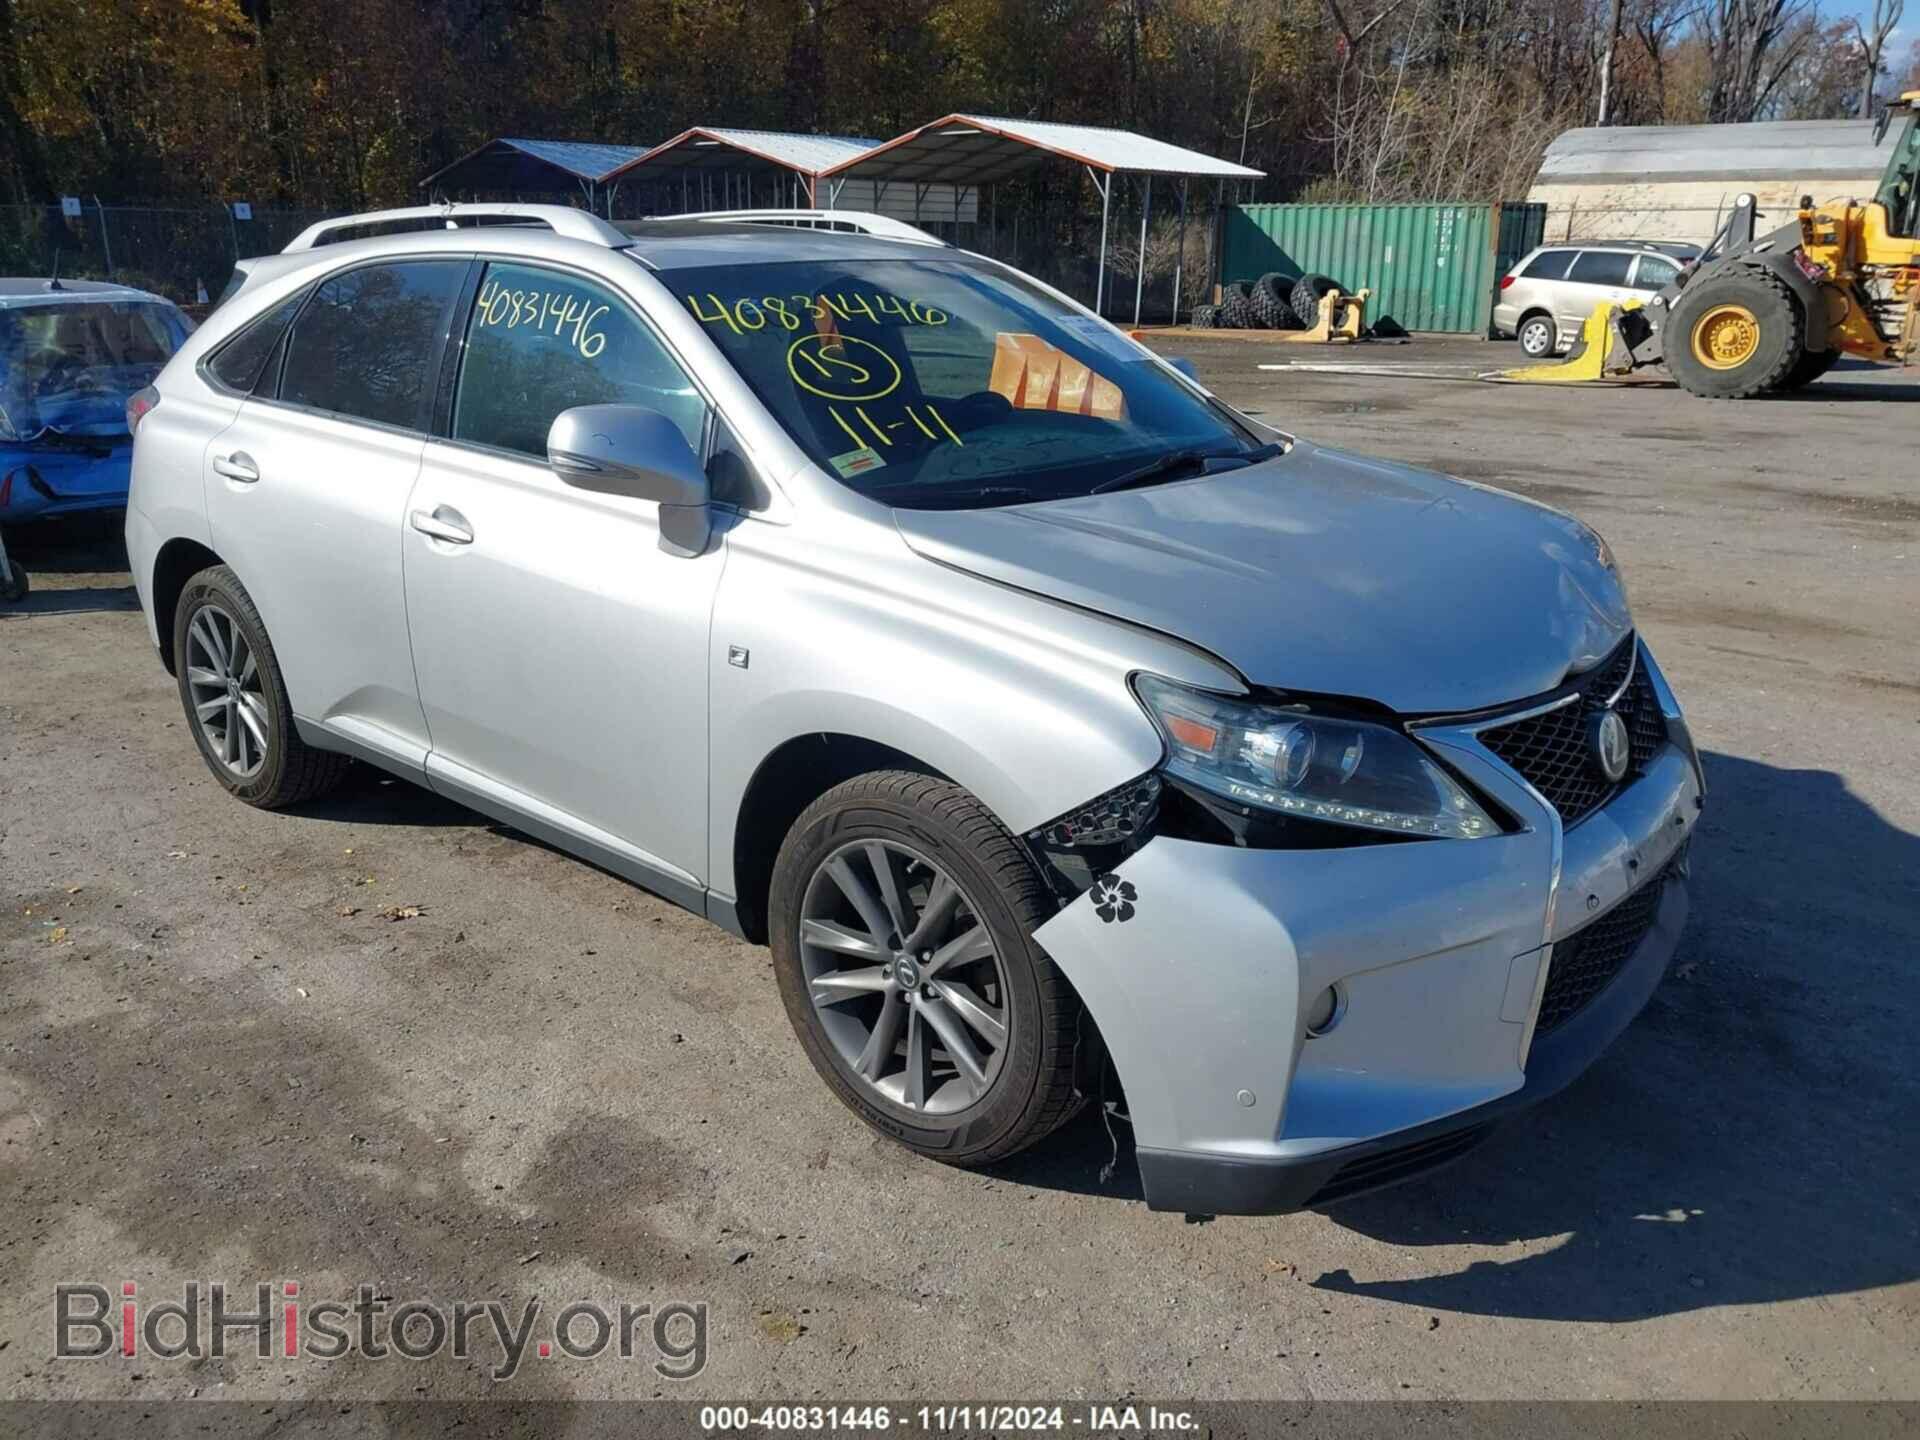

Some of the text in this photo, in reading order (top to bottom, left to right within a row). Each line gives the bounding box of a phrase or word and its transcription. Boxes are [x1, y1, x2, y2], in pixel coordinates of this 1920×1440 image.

[478, 281, 610, 358] 40831446
[688, 293, 948, 335] 40831446
[828, 405, 964, 450] 11-11
